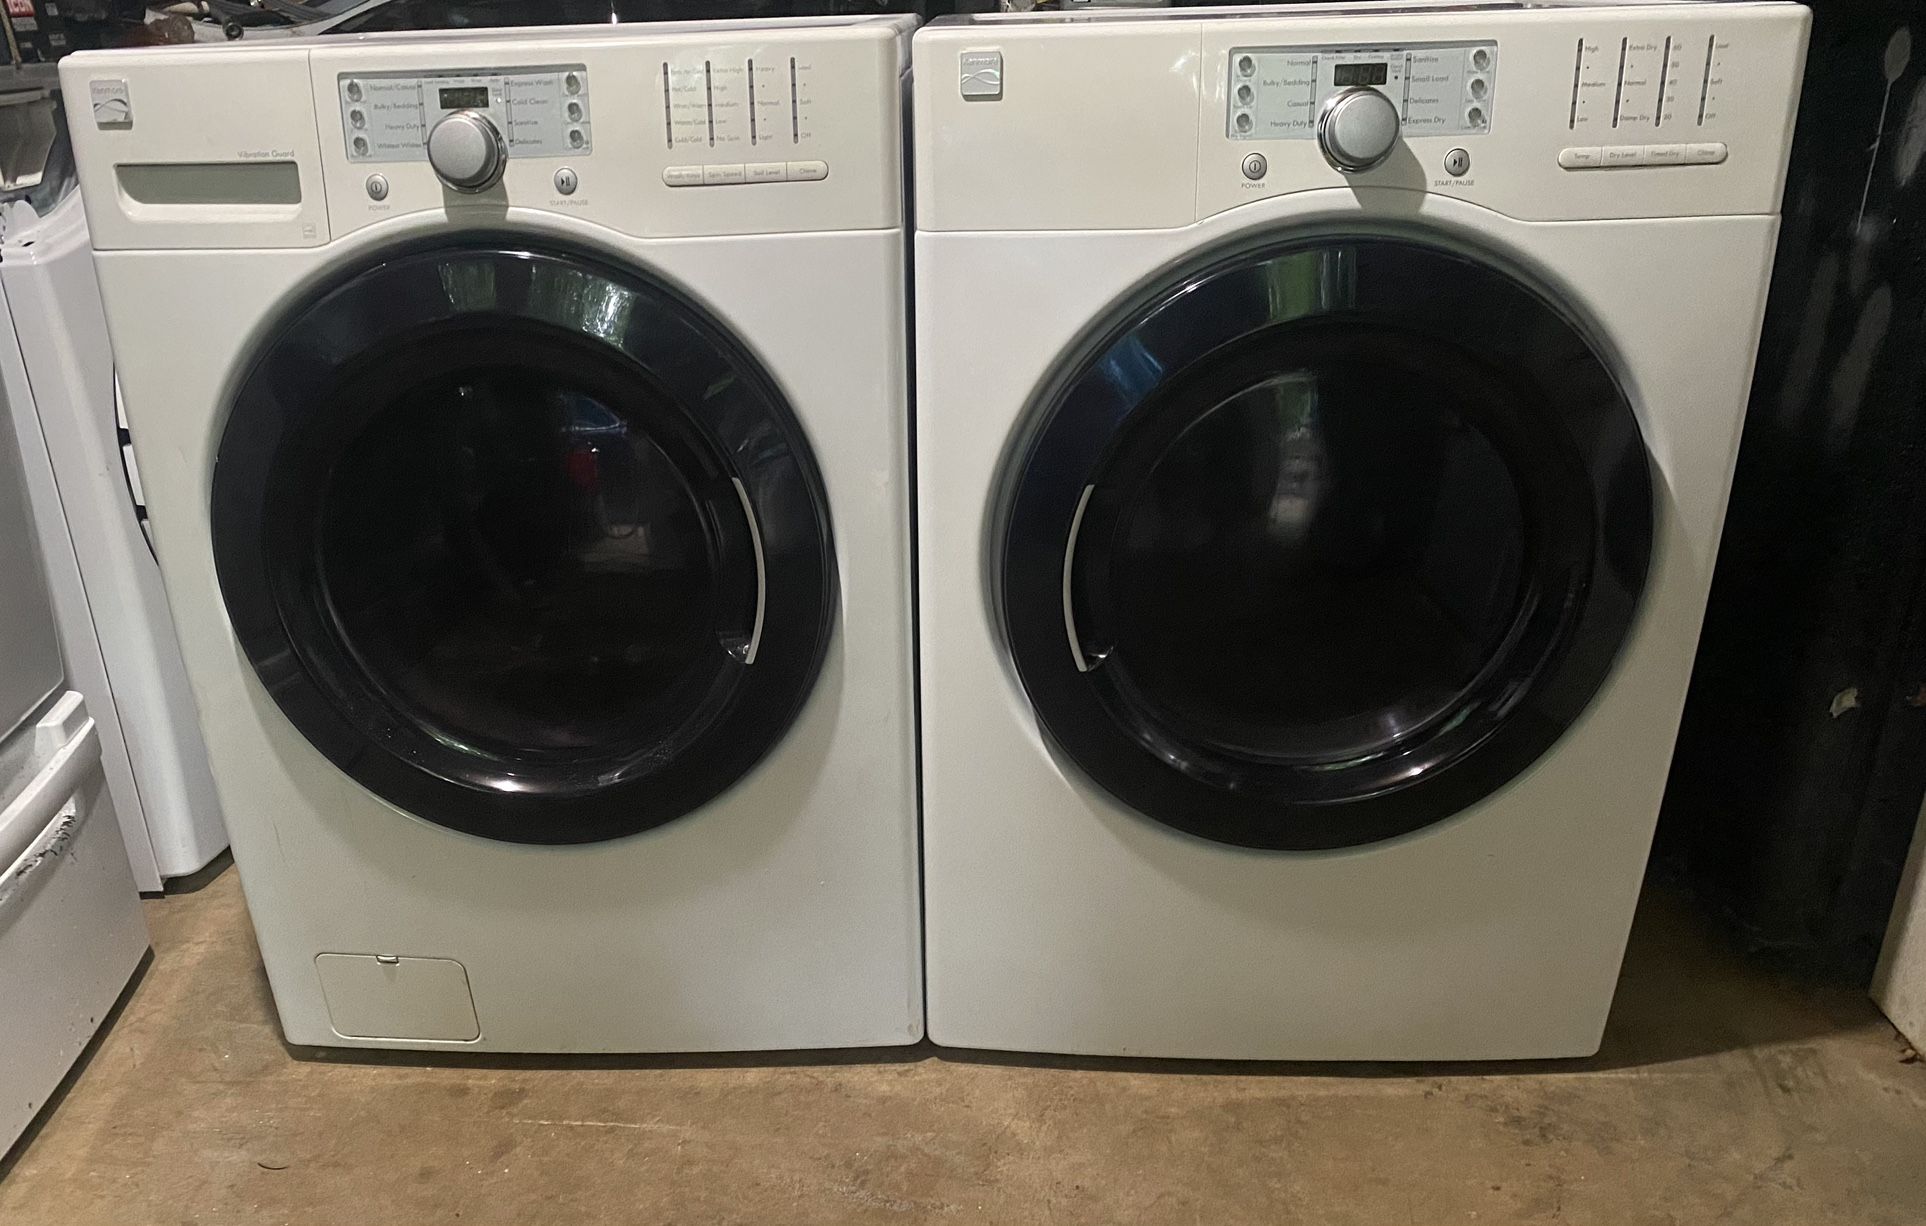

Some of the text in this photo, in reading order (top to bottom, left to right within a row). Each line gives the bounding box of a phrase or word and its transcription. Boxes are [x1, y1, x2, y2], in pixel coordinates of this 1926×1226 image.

[1585, 45, 1598, 53] High
[1646, 44, 1657, 52] Dry
[1287, 99, 1308, 107] Casual
[1271, 119, 1307, 129] Heavy Duty
[1434, 116, 1446, 124] Dry
[271, 150, 295, 158] Guard
[1434, 179, 1475, 187] START/PAUSE
